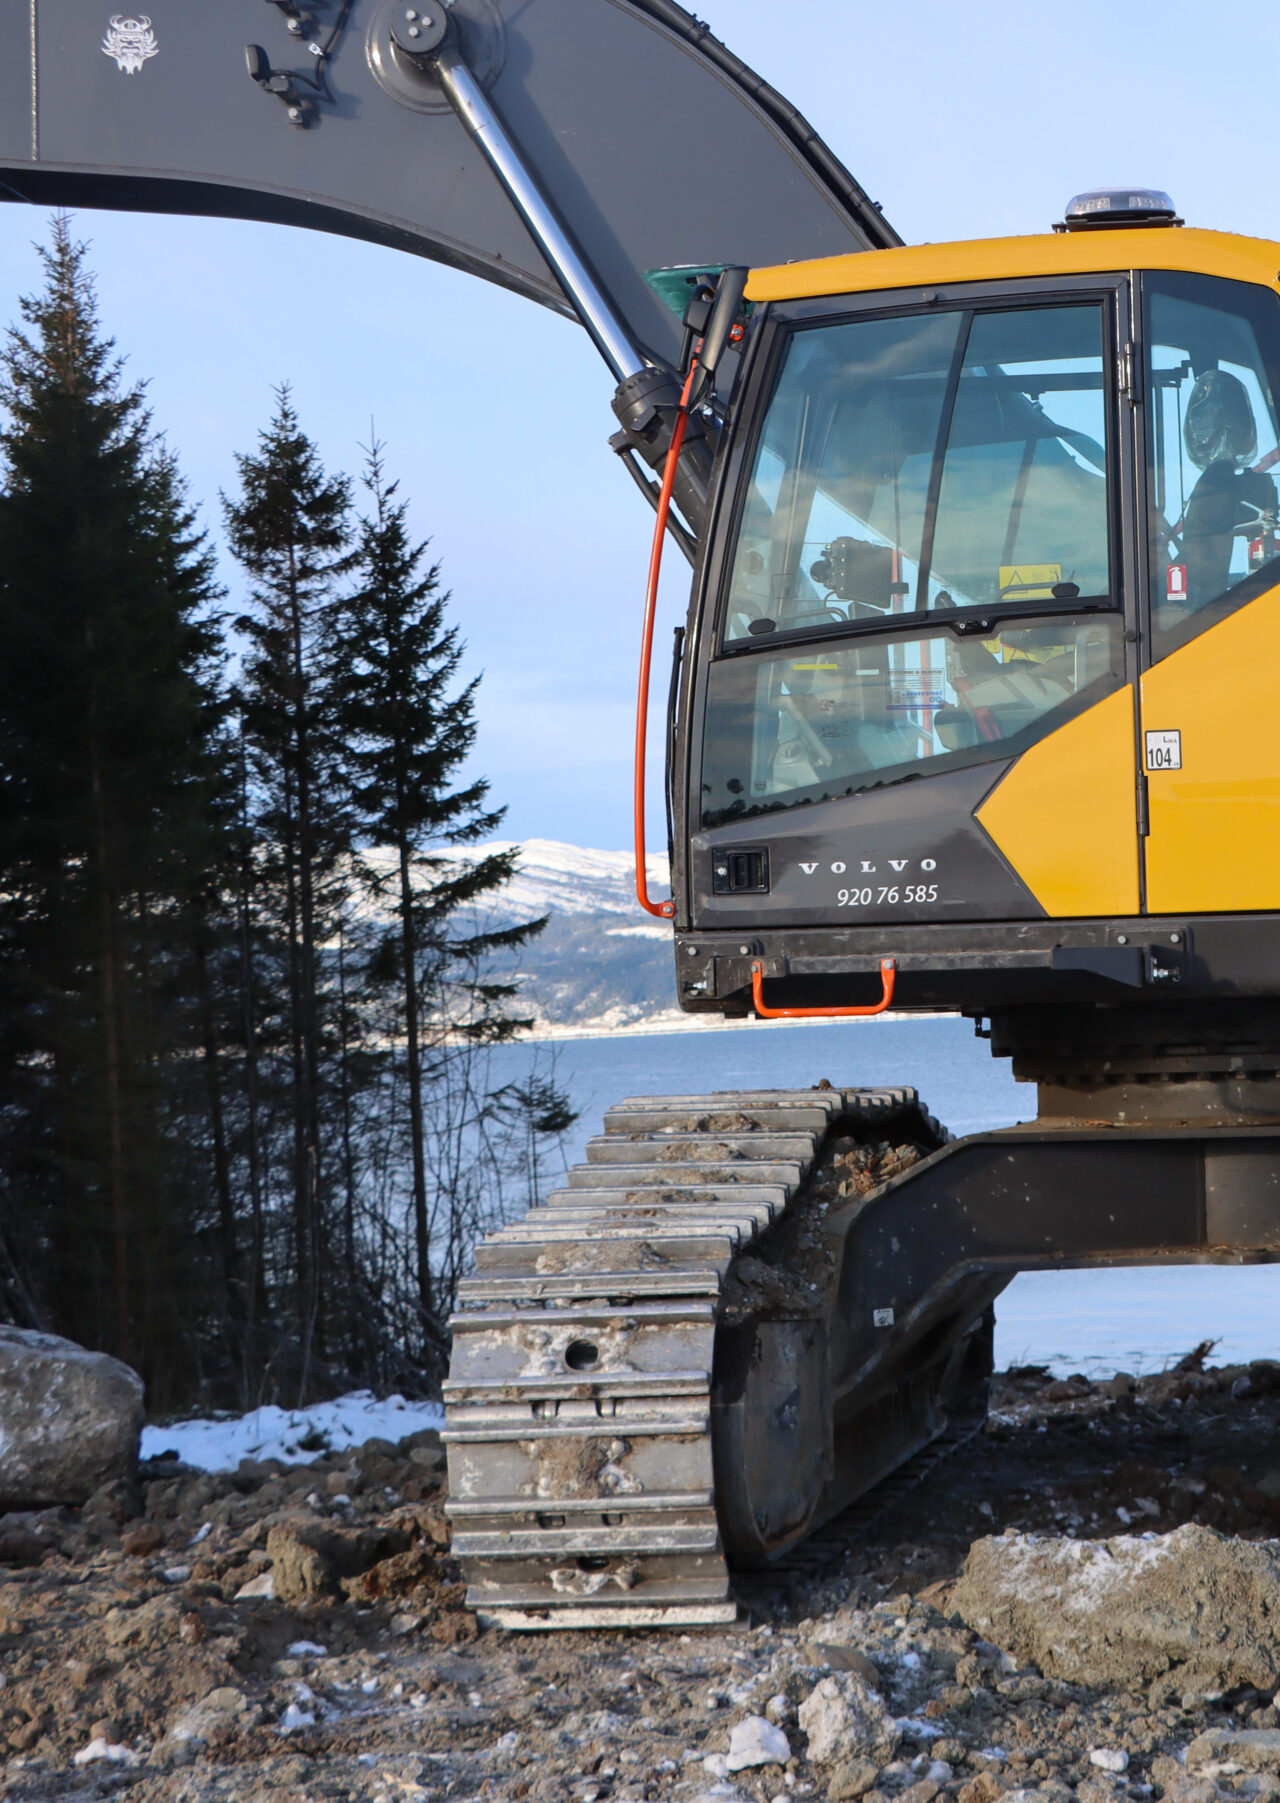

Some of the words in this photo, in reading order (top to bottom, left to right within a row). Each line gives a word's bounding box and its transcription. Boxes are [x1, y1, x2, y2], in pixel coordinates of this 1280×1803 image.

[1149, 747, 1172, 767] 104
[798, 859, 937, 875] VOLVO
[837, 888, 872, 907] 920
[876, 886, 899, 905] 76
[903, 884, 939, 903] 585
